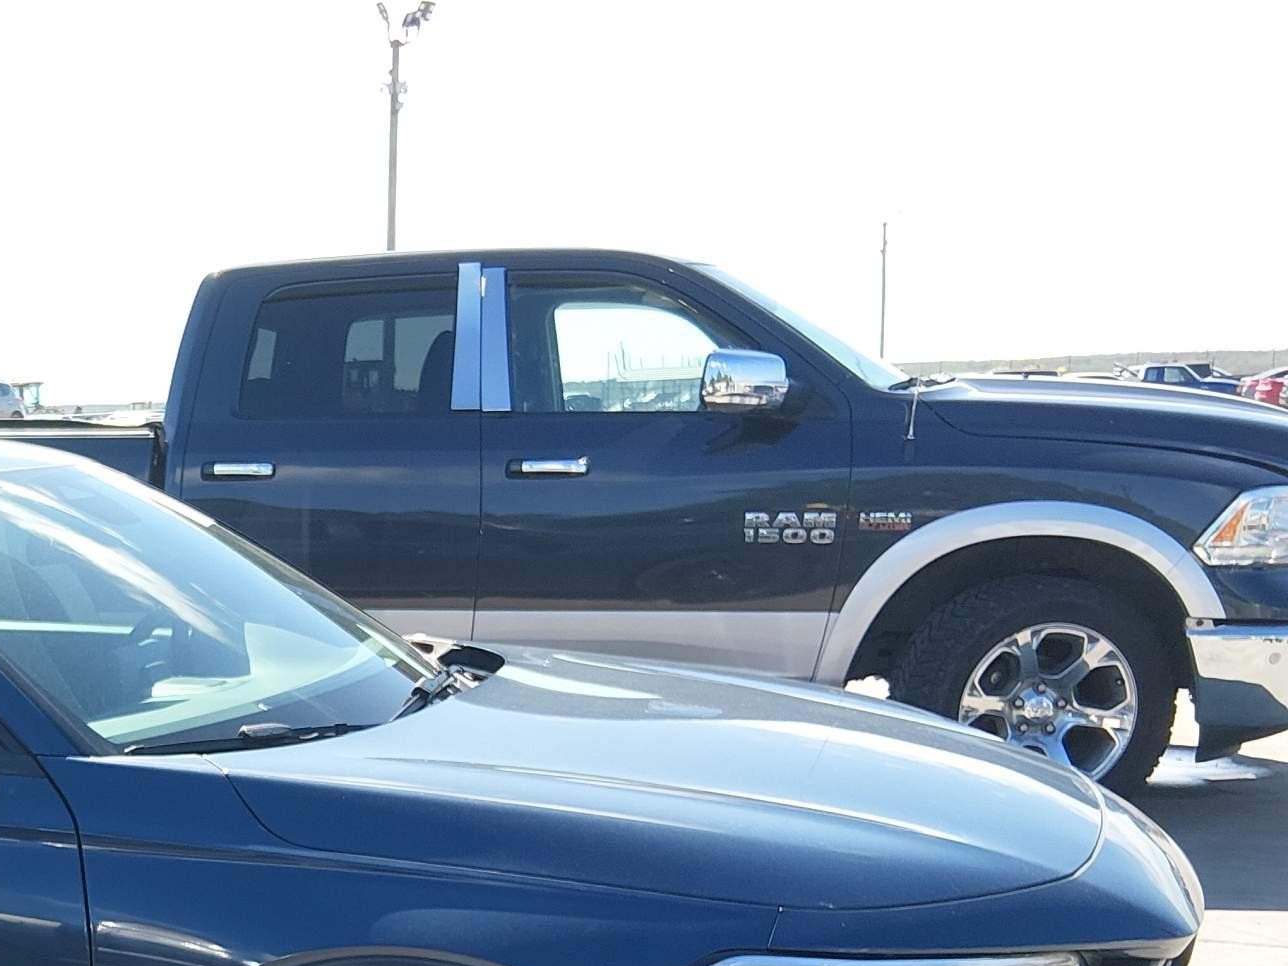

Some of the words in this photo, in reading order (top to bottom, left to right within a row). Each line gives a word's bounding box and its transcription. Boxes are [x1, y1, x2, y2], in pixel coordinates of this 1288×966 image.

[744, 511, 837, 528] RAM
[859, 512, 913, 524] HEMI
[743, 527, 835, 544] 1500
